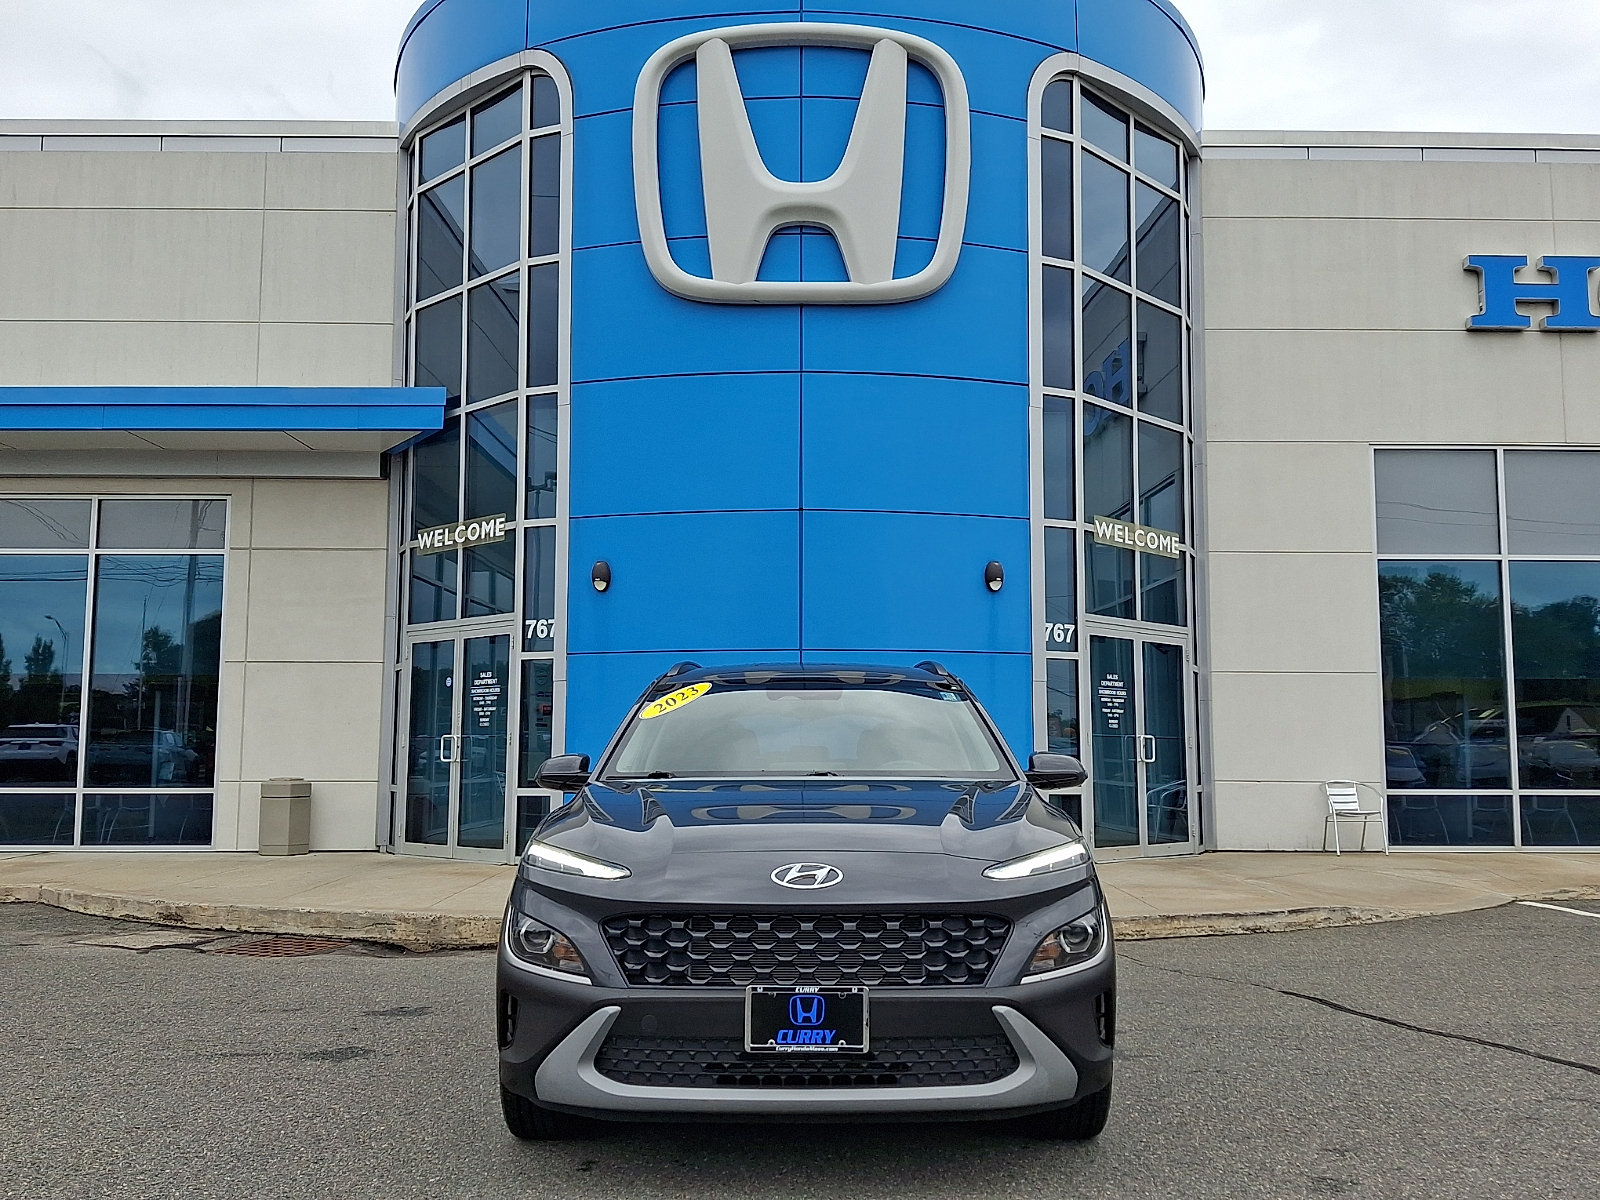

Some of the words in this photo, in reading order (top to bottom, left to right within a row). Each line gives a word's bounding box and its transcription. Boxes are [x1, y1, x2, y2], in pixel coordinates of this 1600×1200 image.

[417, 517, 506, 550] WELCOME
[1094, 519, 1180, 555] WELCOME
[525, 618, 555, 639] 767
[1045, 622, 1076, 643] 767
[653, 687, 699, 713] 2023
[776, 1029, 836, 1044] CURRY
